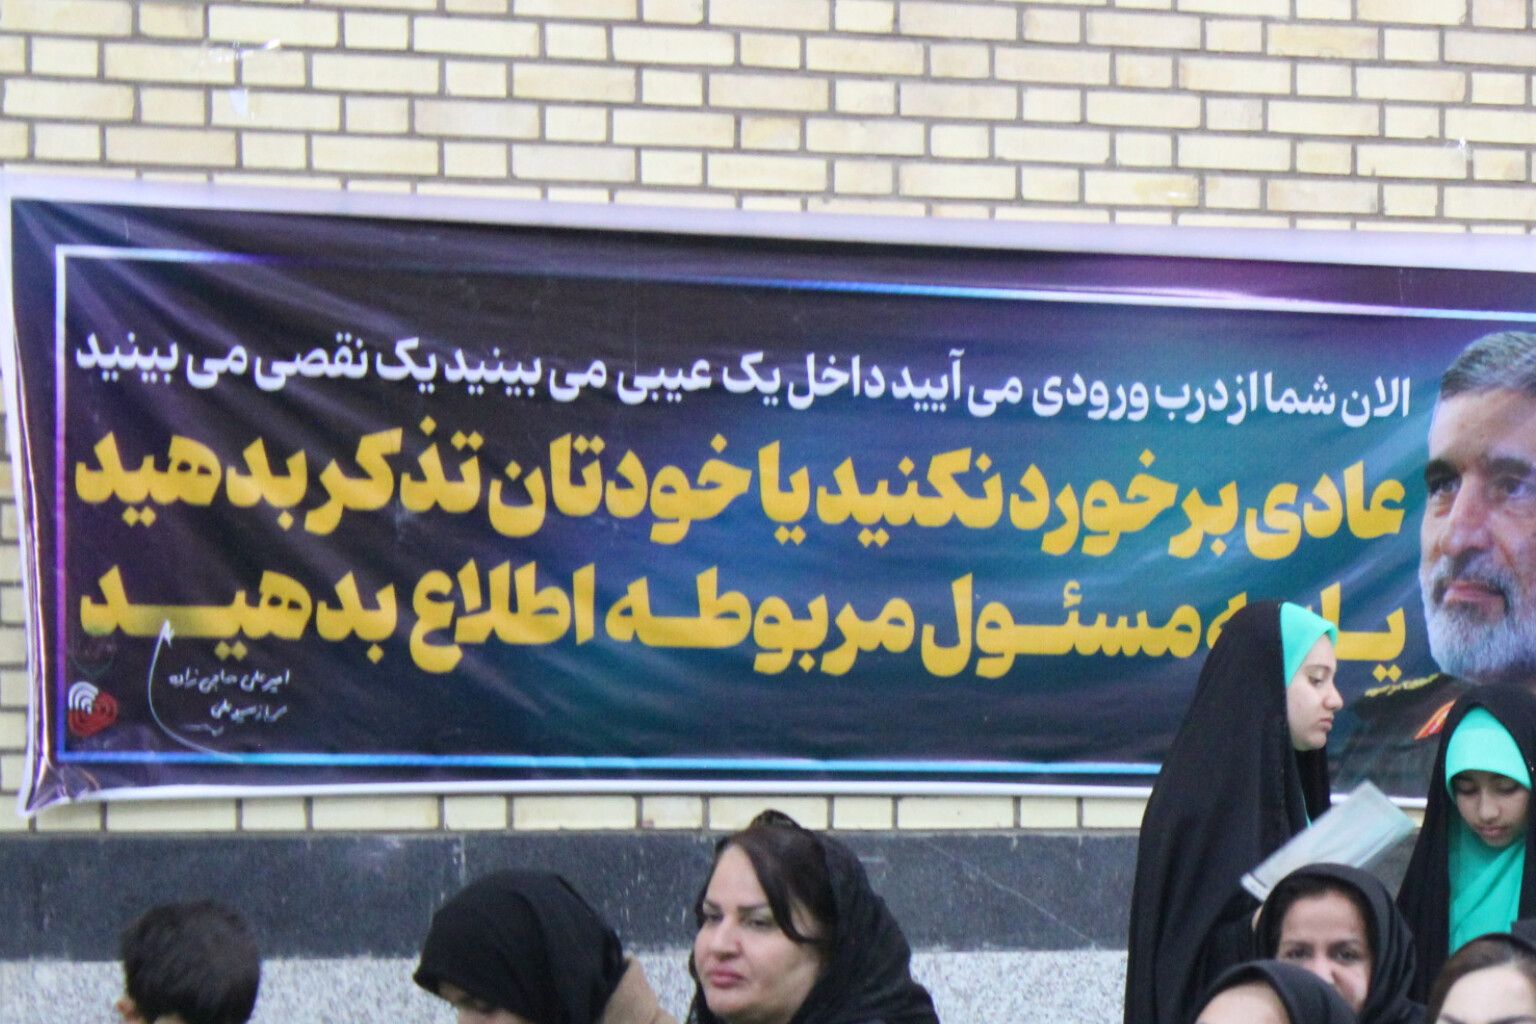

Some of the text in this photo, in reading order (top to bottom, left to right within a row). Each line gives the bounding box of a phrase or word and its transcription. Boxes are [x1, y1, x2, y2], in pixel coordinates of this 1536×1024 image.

[76, 330, 1412, 428] الان شما از درب ورودی می آیید داخل یک عیبی می بینید یک نقصی می بینید
[75, 416, 1406, 560] عادی برخورد نکنید یا خودتان تذکر بدهید
[79, 565, 399, 664] بدهید
[408, 559, 596, 675] اطلاع
[605, 565, 916, 677] مربوطه
[920, 572, 1203, 680] مسئول
